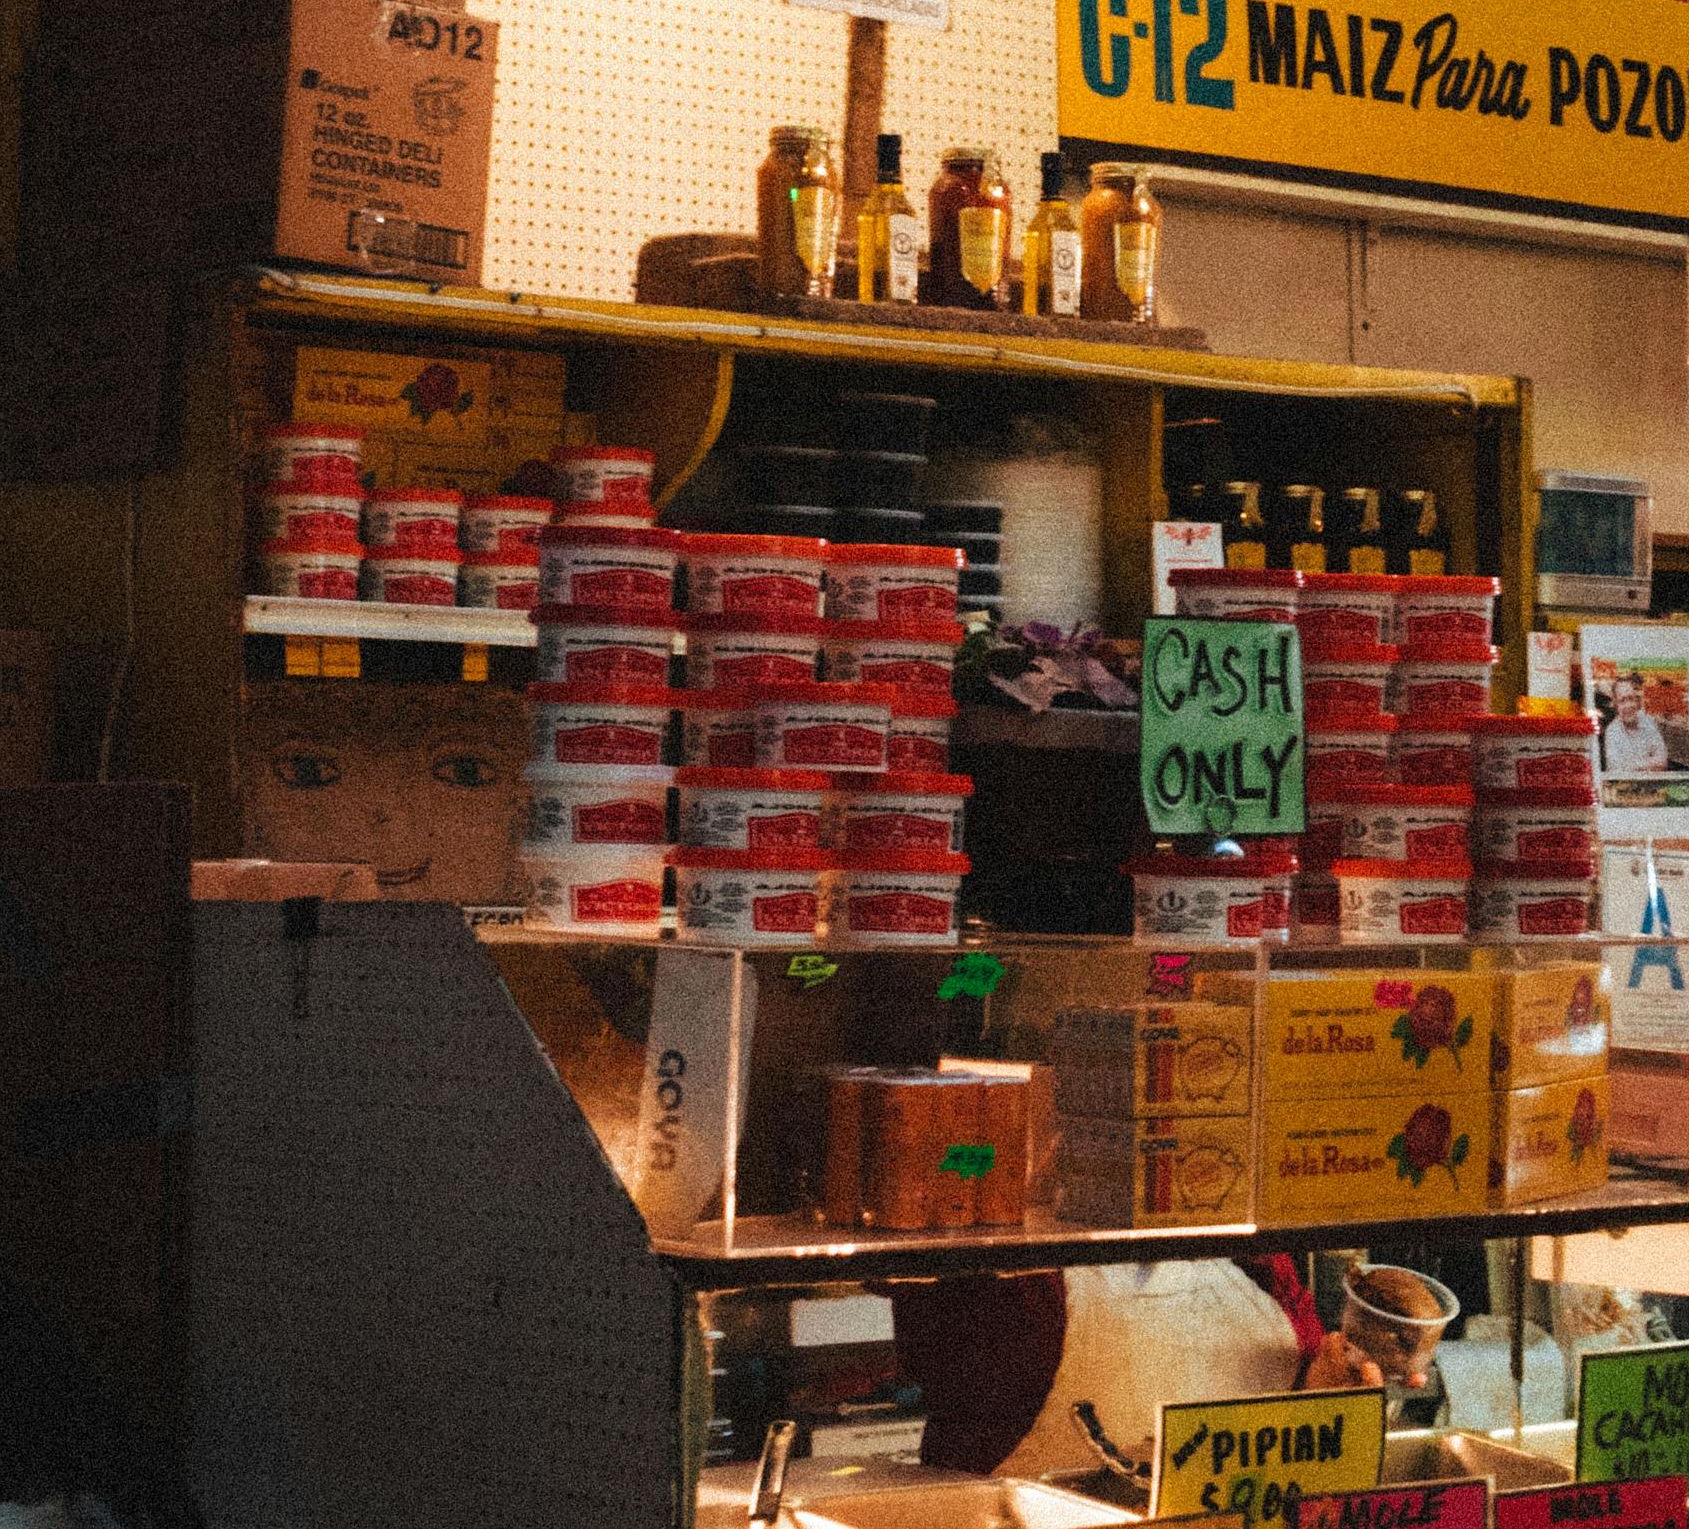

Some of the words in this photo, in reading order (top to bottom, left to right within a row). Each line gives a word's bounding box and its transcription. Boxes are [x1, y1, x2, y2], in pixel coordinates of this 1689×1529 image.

[1246, 0, 1406, 104] MAIZ
[1409, 11, 1531, 121] Para
[312, 125, 394, 155] HINGED
[397, 139, 445, 165] DELI
[316, 103, 338, 124] 12
[311, 148, 443, 189] CONTAINERS
[1153, 627, 1294, 718] CASH
[1154, 735, 1298, 820] ONLY
[1627, 886, 1686, 992] A
[649, 1049, 688, 1171] GOYA
[1211, 1414, 1345, 1475] PIPIAN
[1340, 1486, 1448, 1529] MOLE
